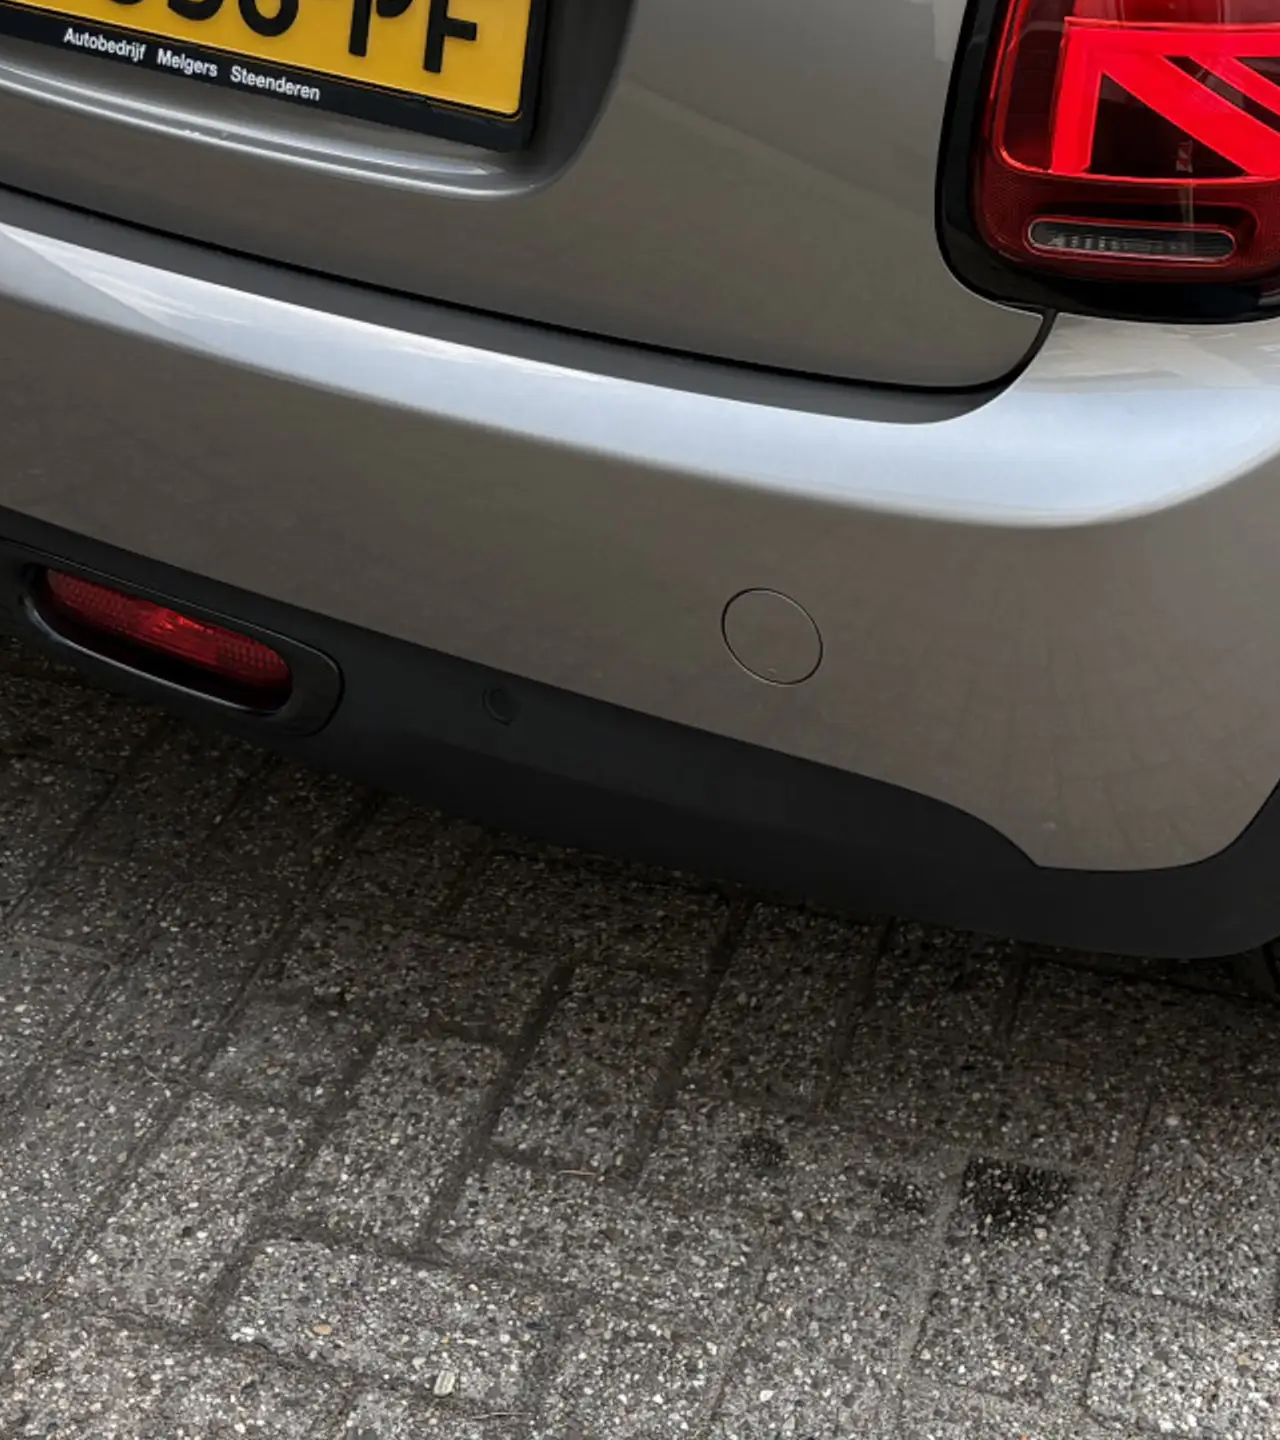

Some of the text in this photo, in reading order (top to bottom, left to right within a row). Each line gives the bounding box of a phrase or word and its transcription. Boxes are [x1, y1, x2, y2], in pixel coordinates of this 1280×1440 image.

[63, 28, 320, 102] Autobedrijf Melgers Steenderen
